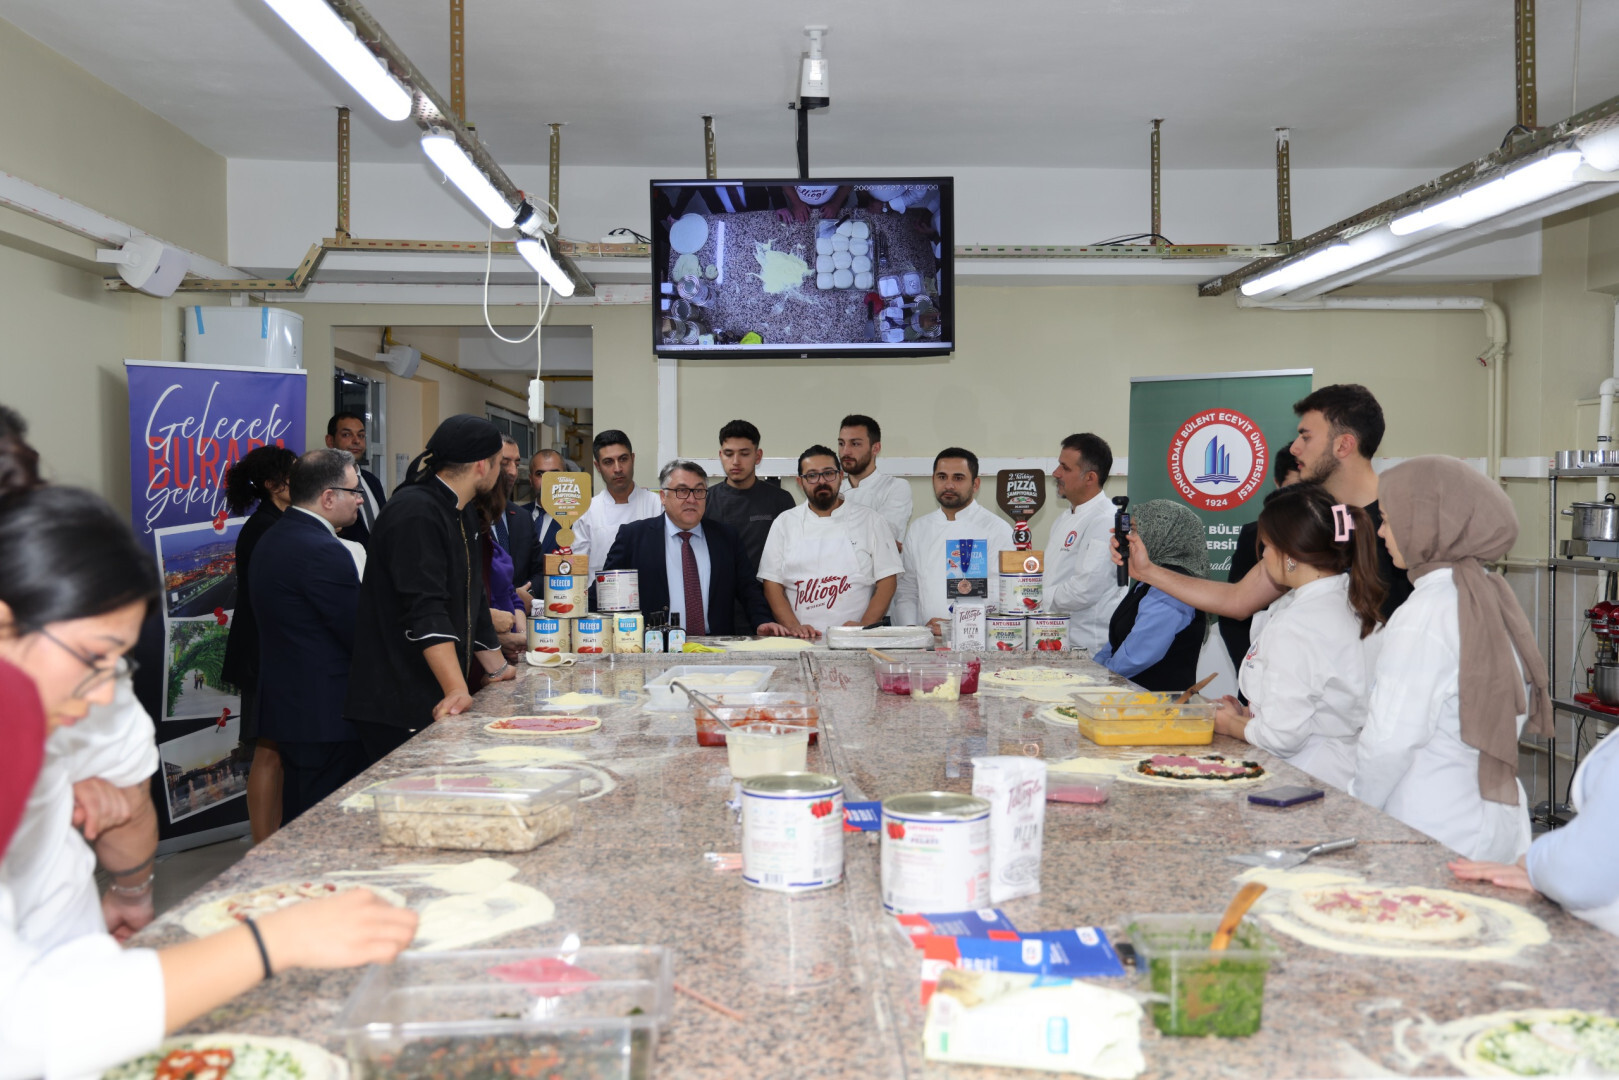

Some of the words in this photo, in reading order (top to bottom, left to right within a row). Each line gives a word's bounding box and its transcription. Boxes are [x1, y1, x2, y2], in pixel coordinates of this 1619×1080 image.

[145, 381, 291, 463] Gelecek
[1180, 412, 1216, 439] BÜLENT
[1218, 412, 1253, 433] ECEVİT
[1171, 438, 1197, 499] ZONGULDAK
[1237, 431, 1265, 501] ÜNİVERSİTESİ
[552, 483, 581, 494] PIZZA
[1007, 480, 1037, 492] PIZZA
[1205, 498, 1228, 507] 1924
[1018, 531, 1026, 542] 3
[1208, 523, 1242, 535] BÜLE
